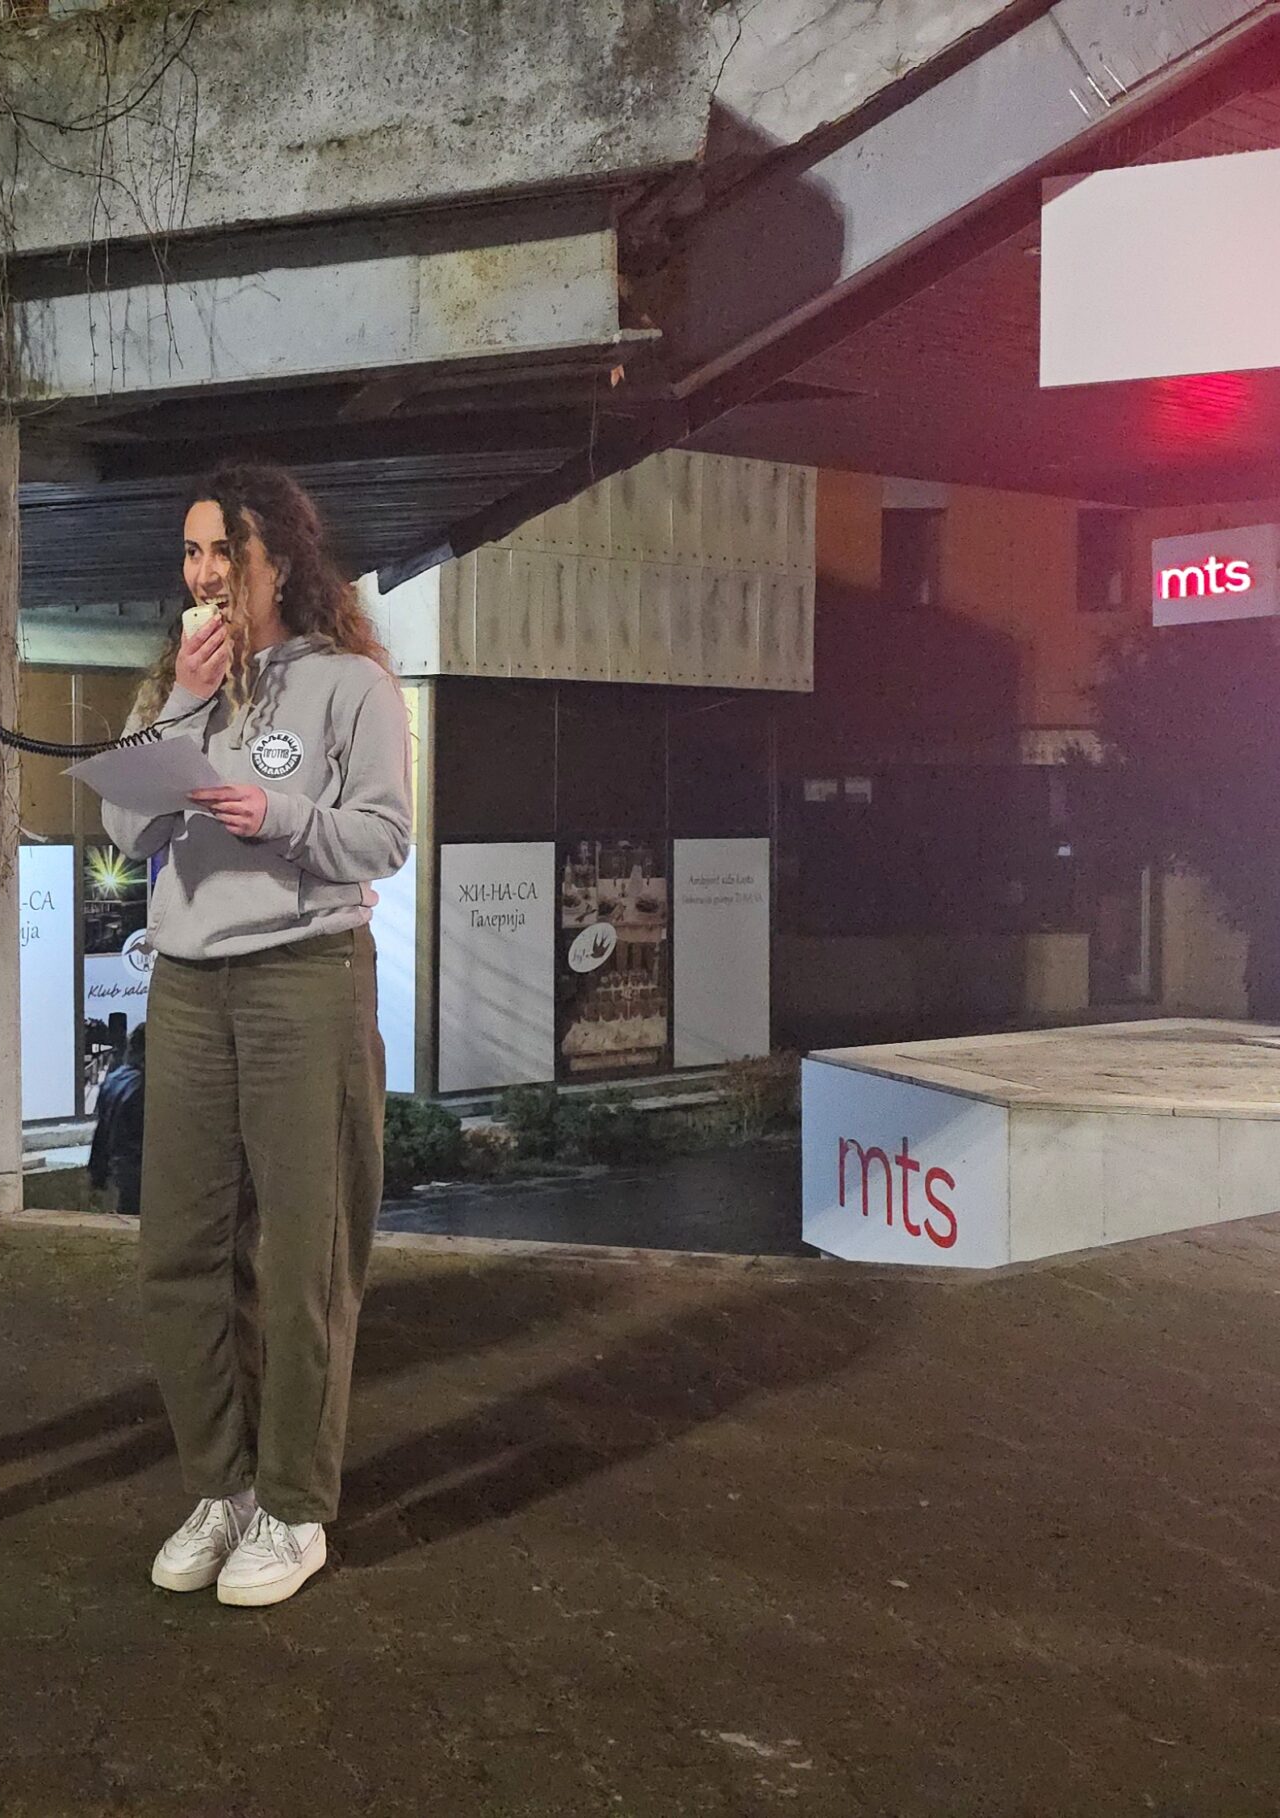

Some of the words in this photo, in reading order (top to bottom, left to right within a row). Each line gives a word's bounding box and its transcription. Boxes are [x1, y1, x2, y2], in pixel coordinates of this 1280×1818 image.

[1161, 555, 1251, 599] mts
[459, 881, 538, 902] ЖИ-НА-СА
[470, 908, 526, 932] Галерија
[88, 983, 121, 999] Klub
[838, 1136, 958, 1249] mts
